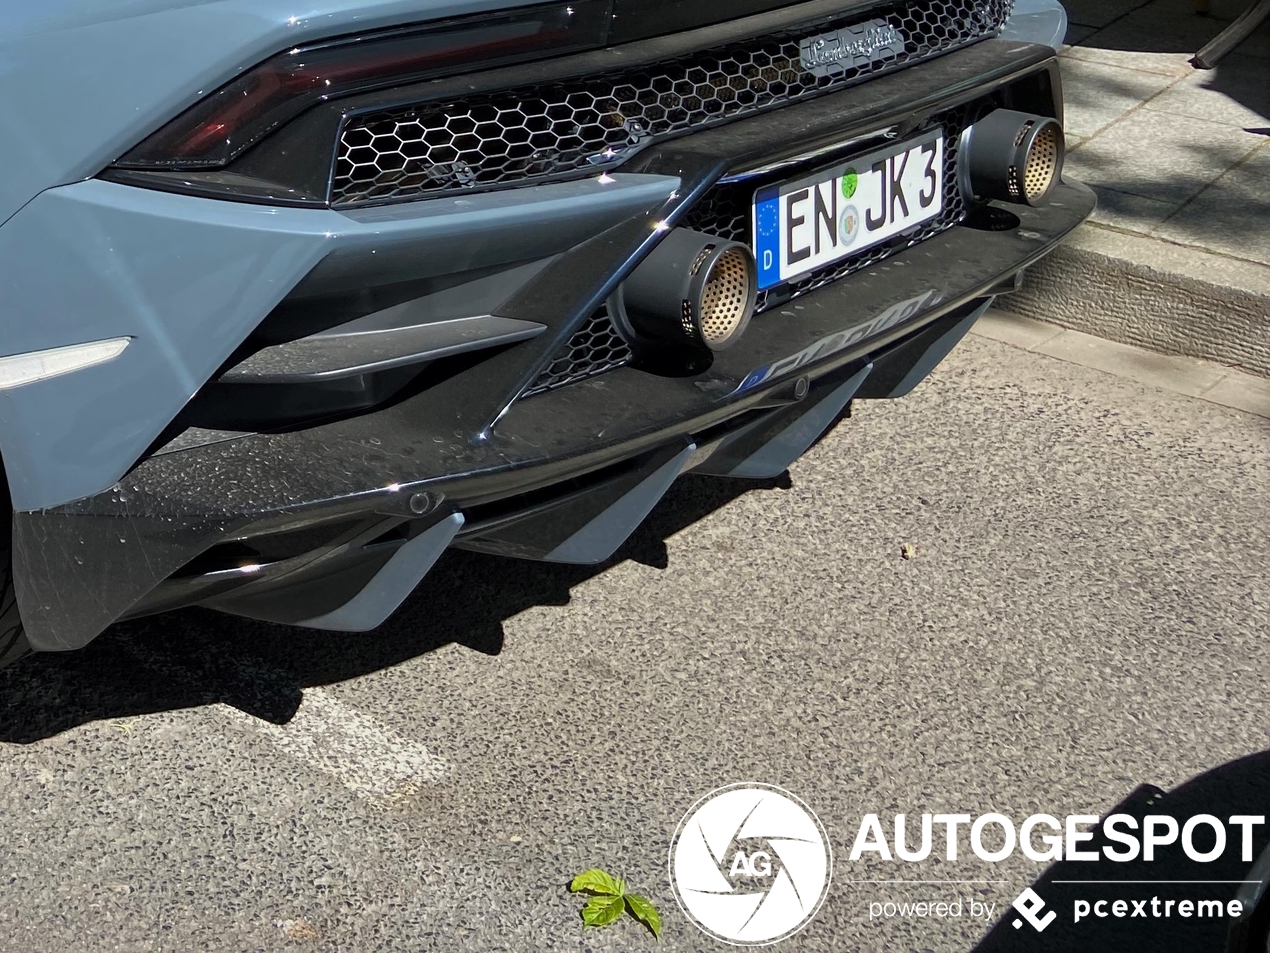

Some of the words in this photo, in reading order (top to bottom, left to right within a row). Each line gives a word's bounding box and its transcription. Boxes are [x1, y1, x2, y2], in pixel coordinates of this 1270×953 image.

[786, 177, 837, 266] EN
[865, 150, 910, 232] JK
[918, 139, 937, 209] 3
[763, 249, 773, 271] D
